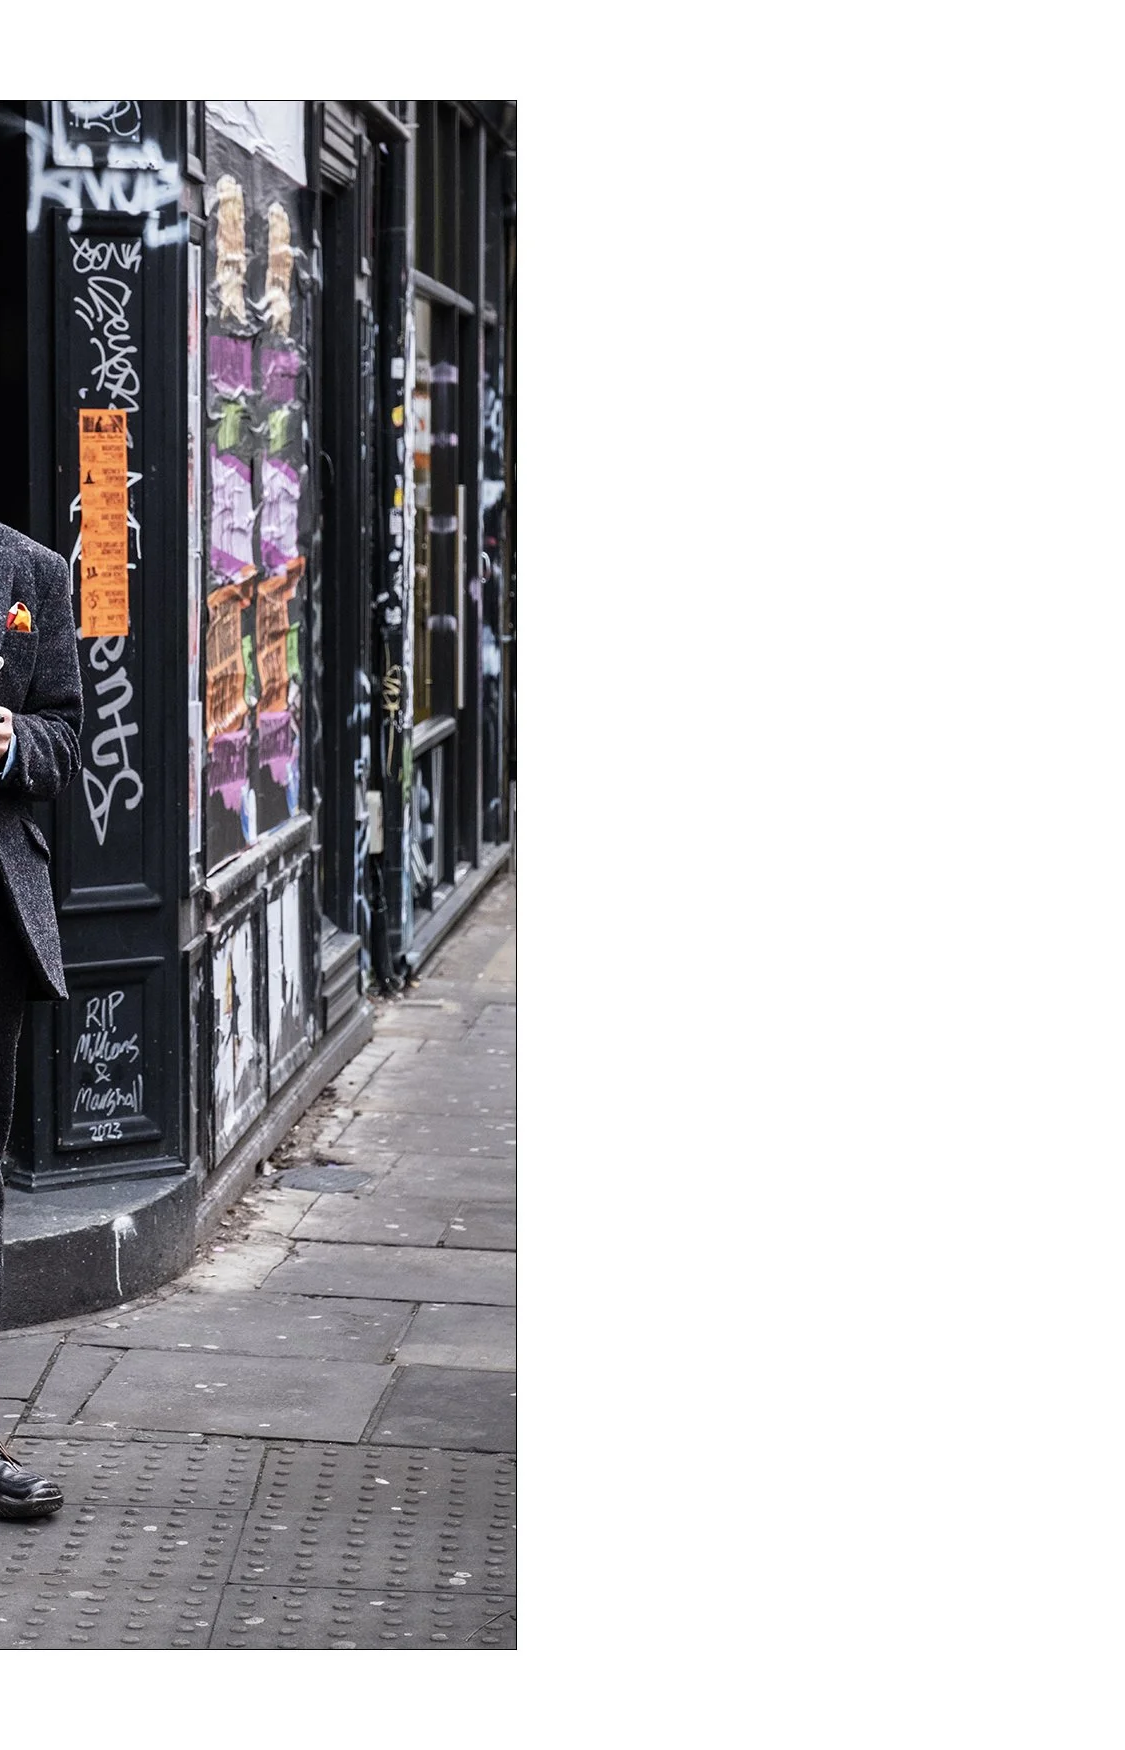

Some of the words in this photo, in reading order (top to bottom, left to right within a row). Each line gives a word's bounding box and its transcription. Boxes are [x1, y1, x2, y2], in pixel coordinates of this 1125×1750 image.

[86, 990, 125, 1032] RIP
[94, 1062, 111, 1084] &
[89, 1122, 124, 1142] 2023
